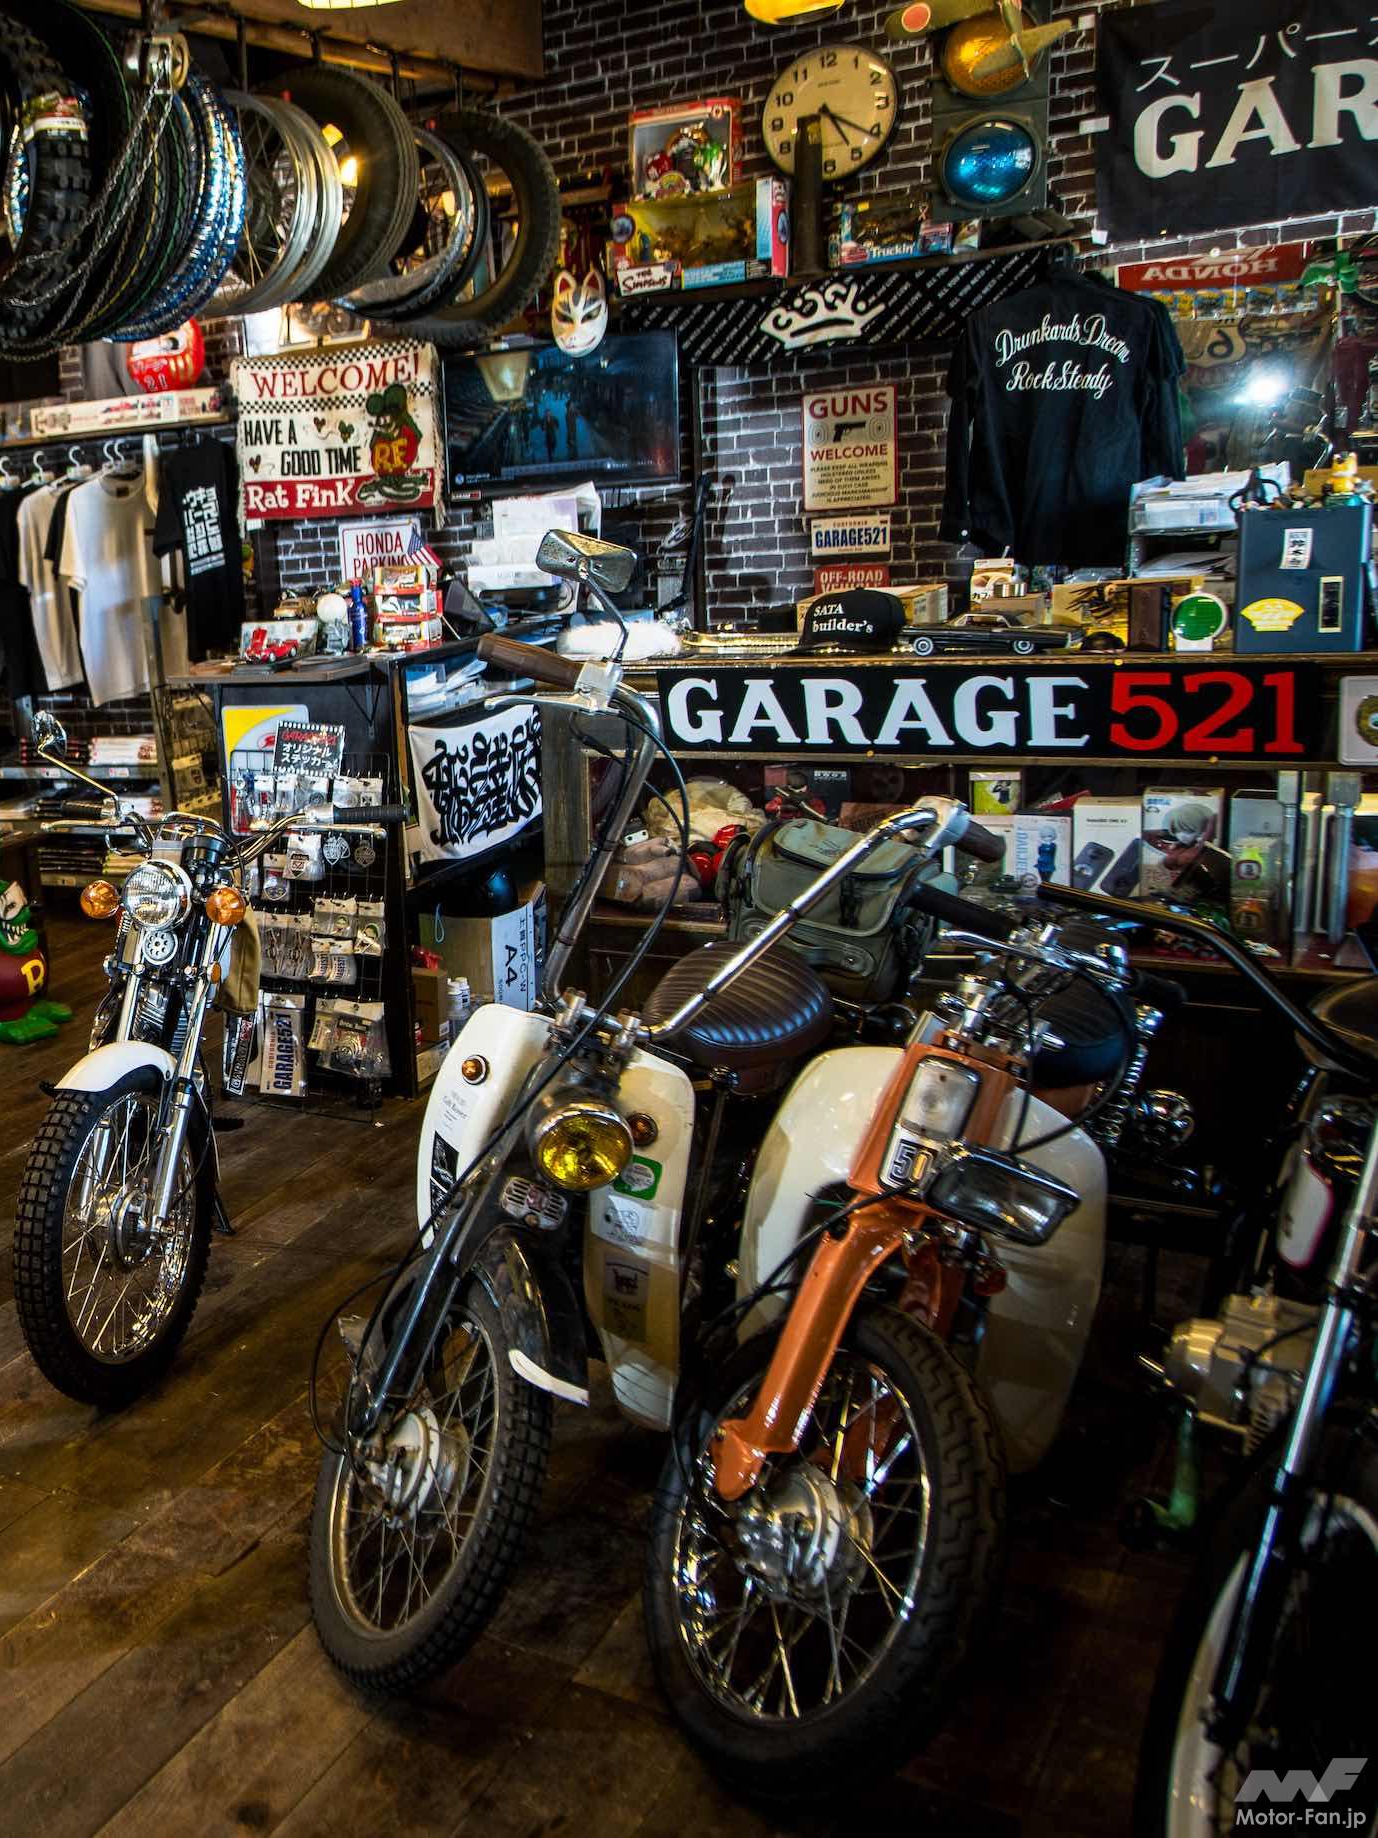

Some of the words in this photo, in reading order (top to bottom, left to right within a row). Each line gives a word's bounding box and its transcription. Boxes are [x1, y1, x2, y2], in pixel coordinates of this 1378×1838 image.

[820, 53, 837, 68] 12
[853, 55, 859, 69] 1
[1135, 17, 1378, 92] スーパー
[792, 69, 808, 83] 11
[870, 71, 881, 85] 2
[775, 92, 794, 106] 10
[251, 353, 419, 398] WELCOME!
[1006, 360, 1053, 392] Rock
[1052, 360, 1113, 400] Steady
[809, 391, 888, 419] GUNS
[243, 419, 283, 446] HAVE
[288, 420, 297, 445] A
[281, 450, 321, 476] GOOD
[326, 446, 361, 475] TIME
[811, 444, 888, 461] WELCOME
[246, 482, 289, 512] Rat
[296, 479, 355, 509] Fink
[356, 531, 403, 555] HONDA
[815, 527, 887, 548] GARAGE521
[821, 569, 883, 583] OFF-ROAD
[813, 603, 844, 617] SATA
[812, 618, 873, 633] builder's
[667, 675, 1090, 748] GARAGE
[1109, 671, 1305, 754] 521
[505, 944, 518, 988] A4
[273, 1013, 295, 1090] GARAGE521
[890, 1142, 933, 1183] 50
